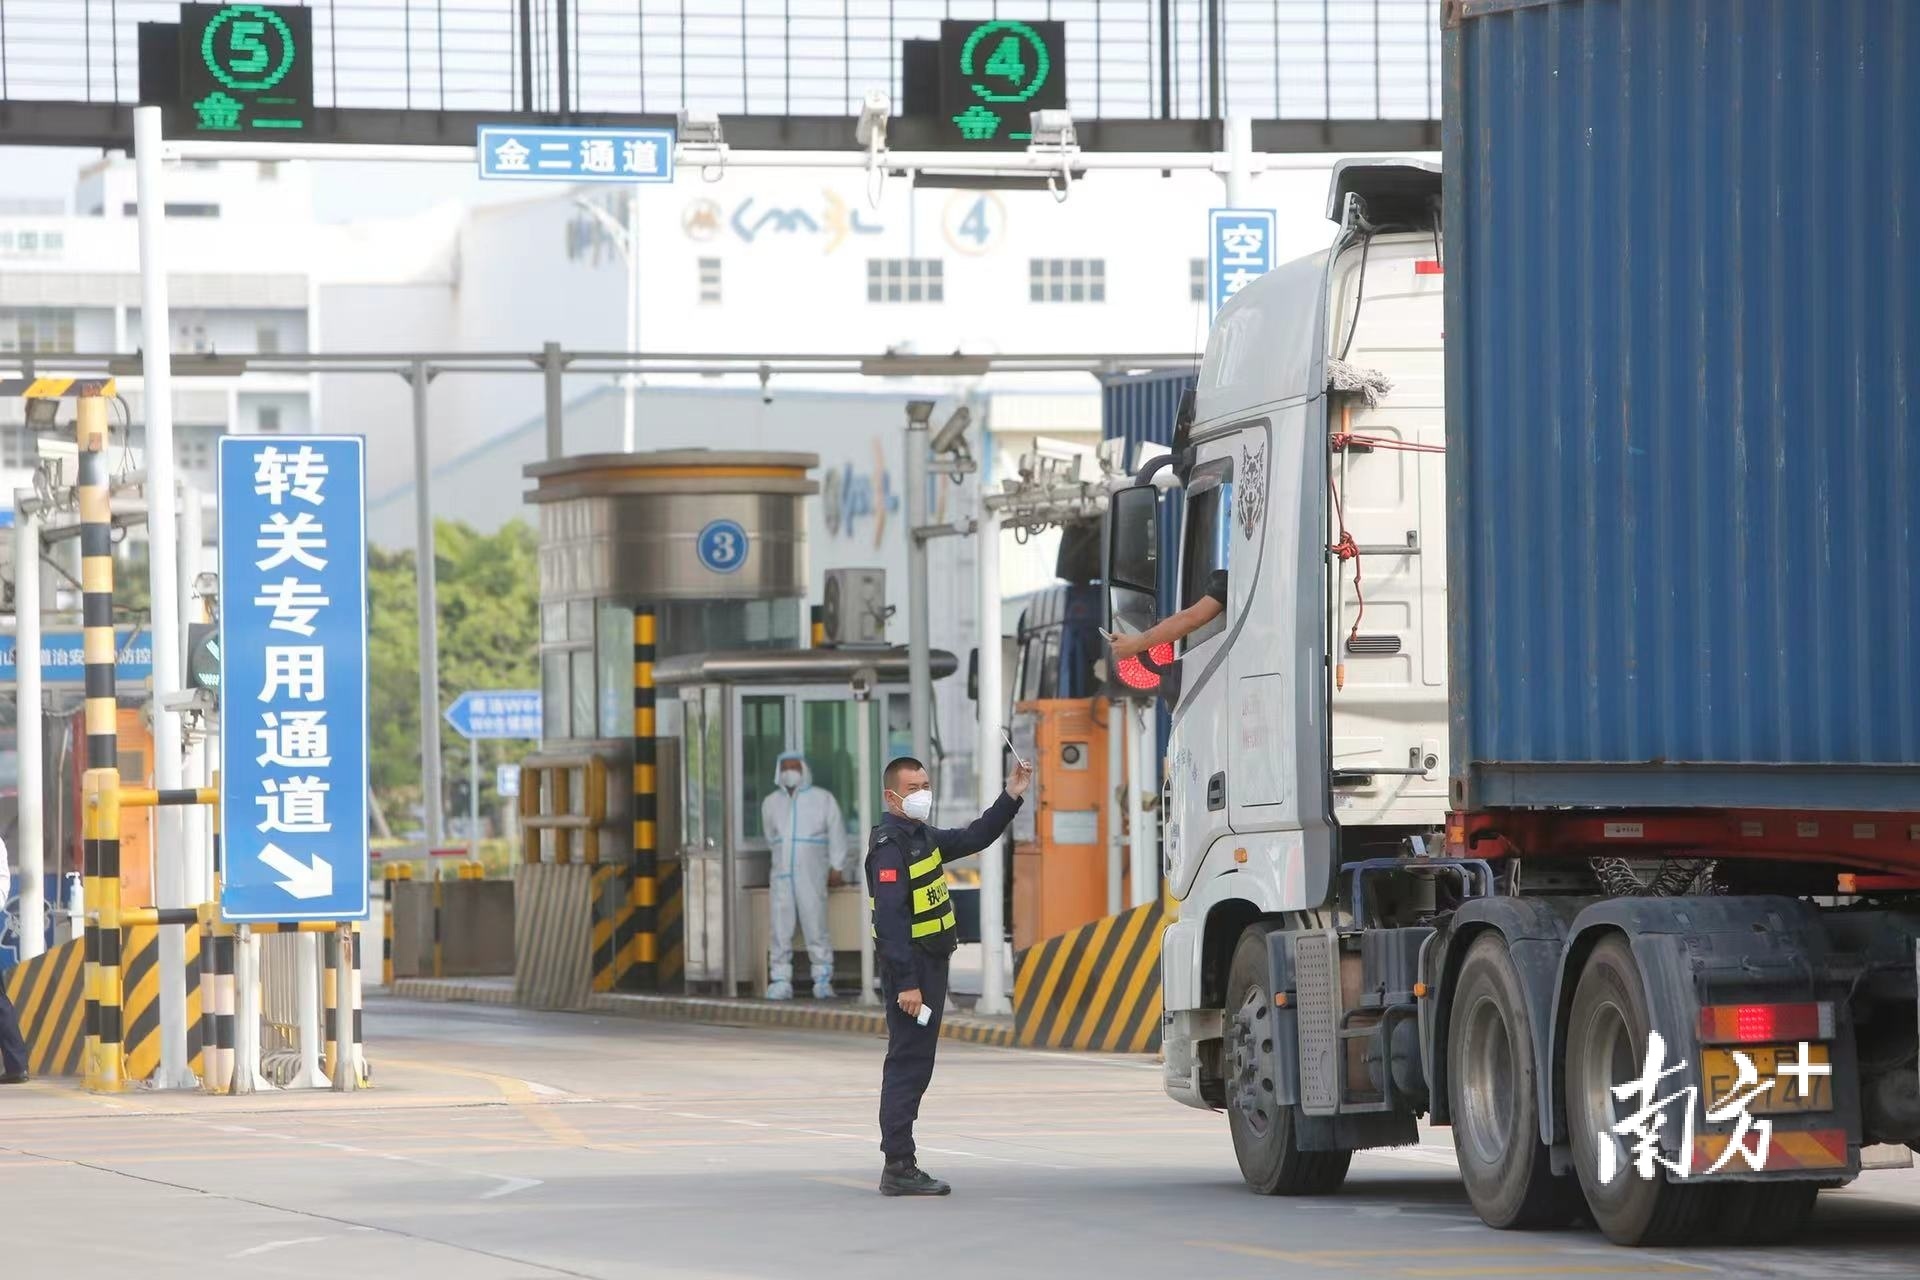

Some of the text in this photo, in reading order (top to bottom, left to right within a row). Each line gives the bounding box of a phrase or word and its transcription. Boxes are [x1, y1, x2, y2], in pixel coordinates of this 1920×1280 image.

[193, 91, 303, 130] 金二
[495, 138, 658, 174] 金二通道
[958, 195, 990, 245] 4
[712, 532, 735, 562] 3
[254, 445, 332, 833] 转关专用通道
